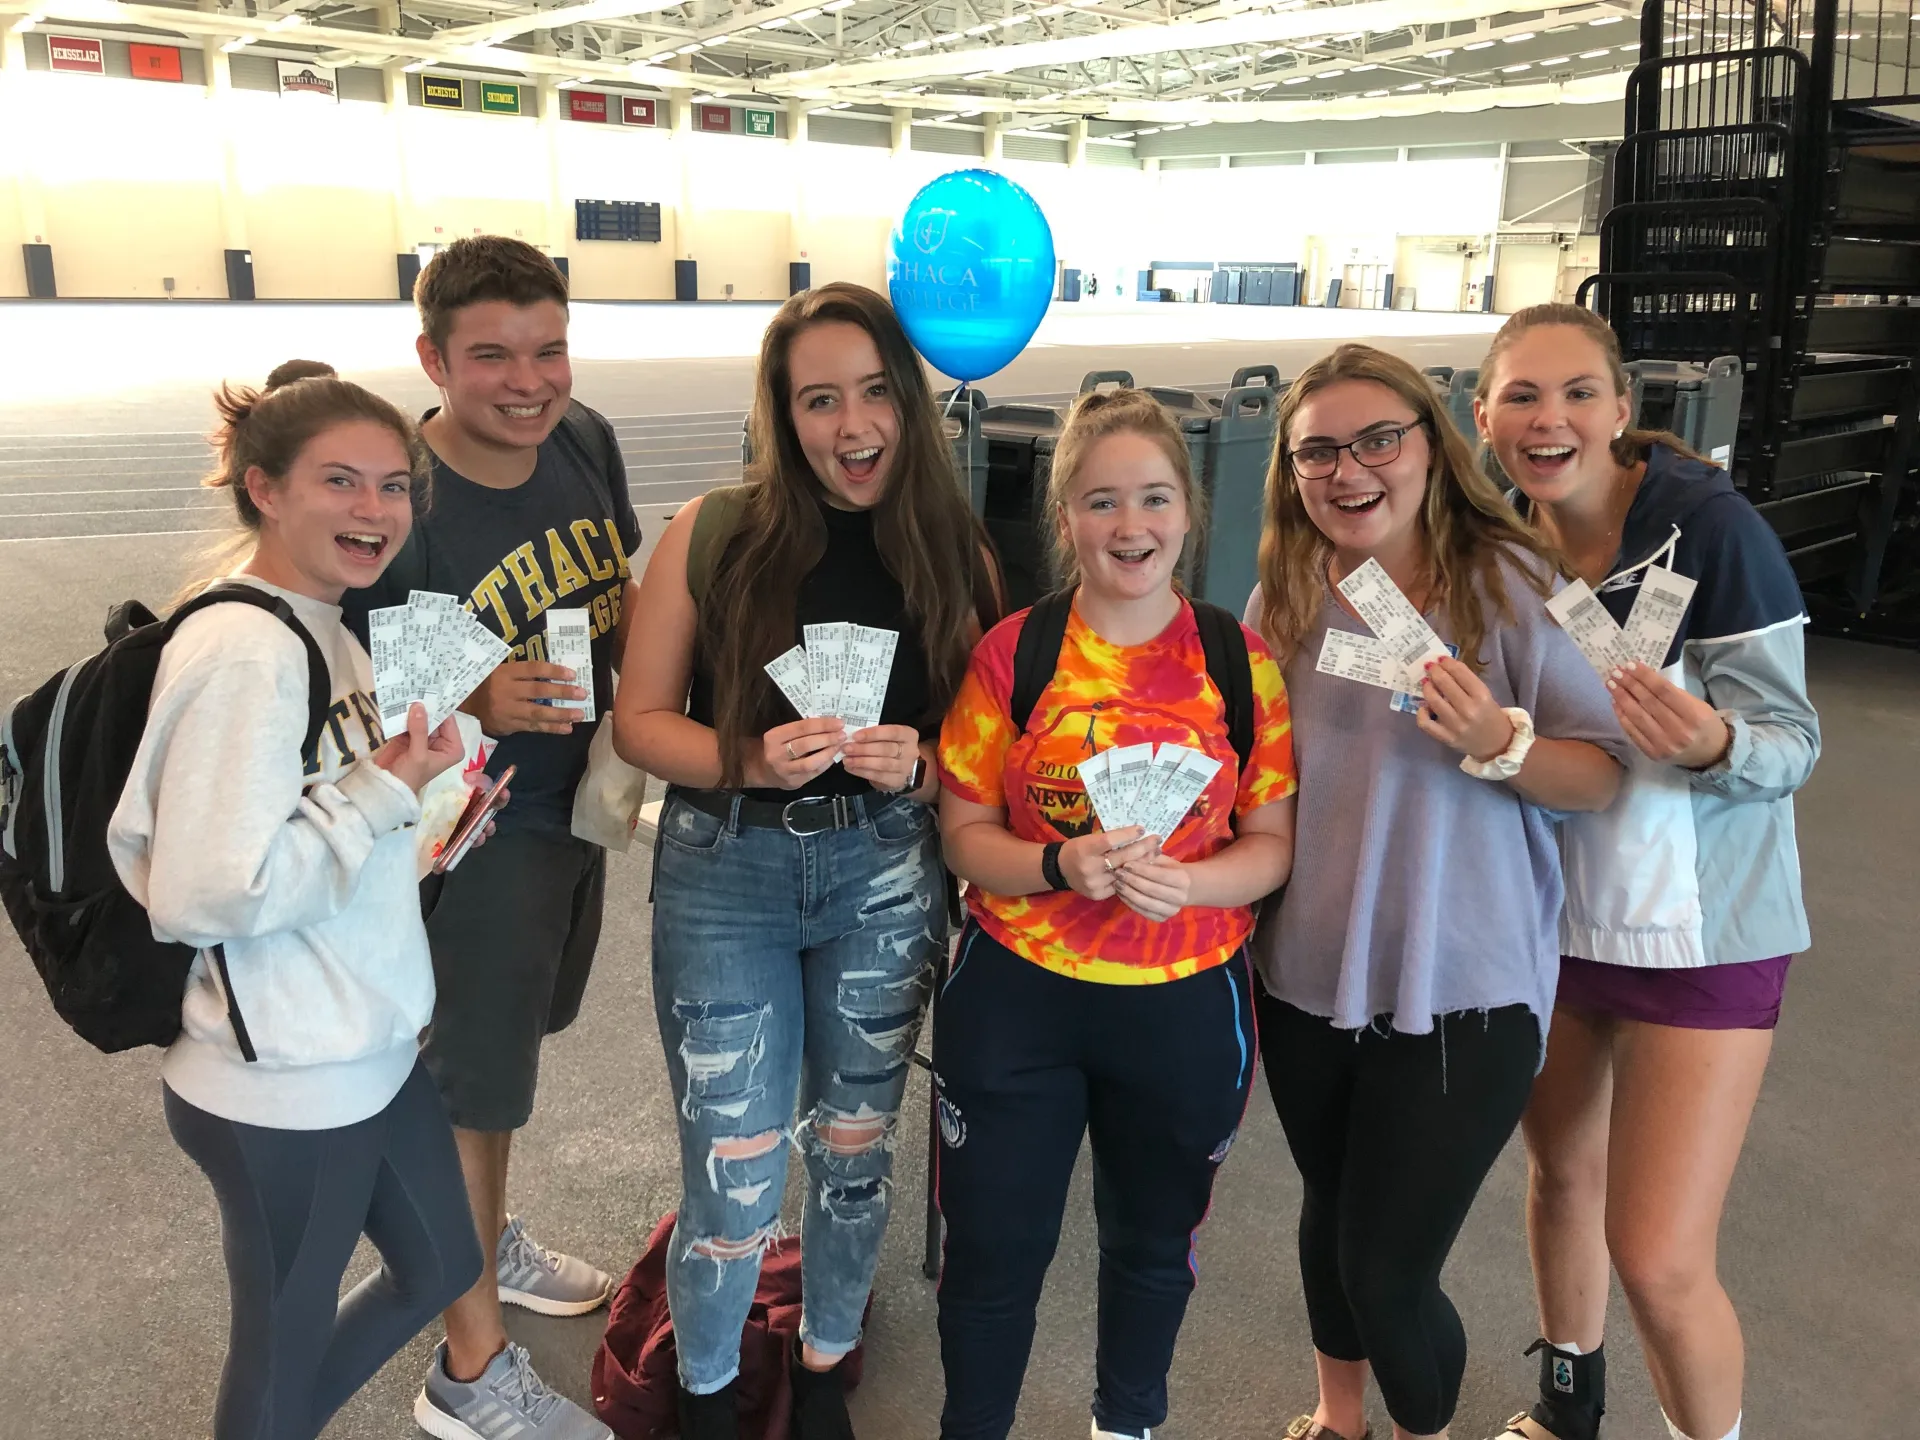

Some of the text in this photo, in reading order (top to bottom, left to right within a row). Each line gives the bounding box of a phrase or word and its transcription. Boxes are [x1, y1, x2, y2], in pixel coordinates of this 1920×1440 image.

[52, 47, 100, 62] RENSSELAER
[427, 85, 459, 99] ROCHESTER
[891, 261, 980, 288] THACA
[1036, 760, 1078, 780] 2010
[1025, 784, 1082, 809] NEW
